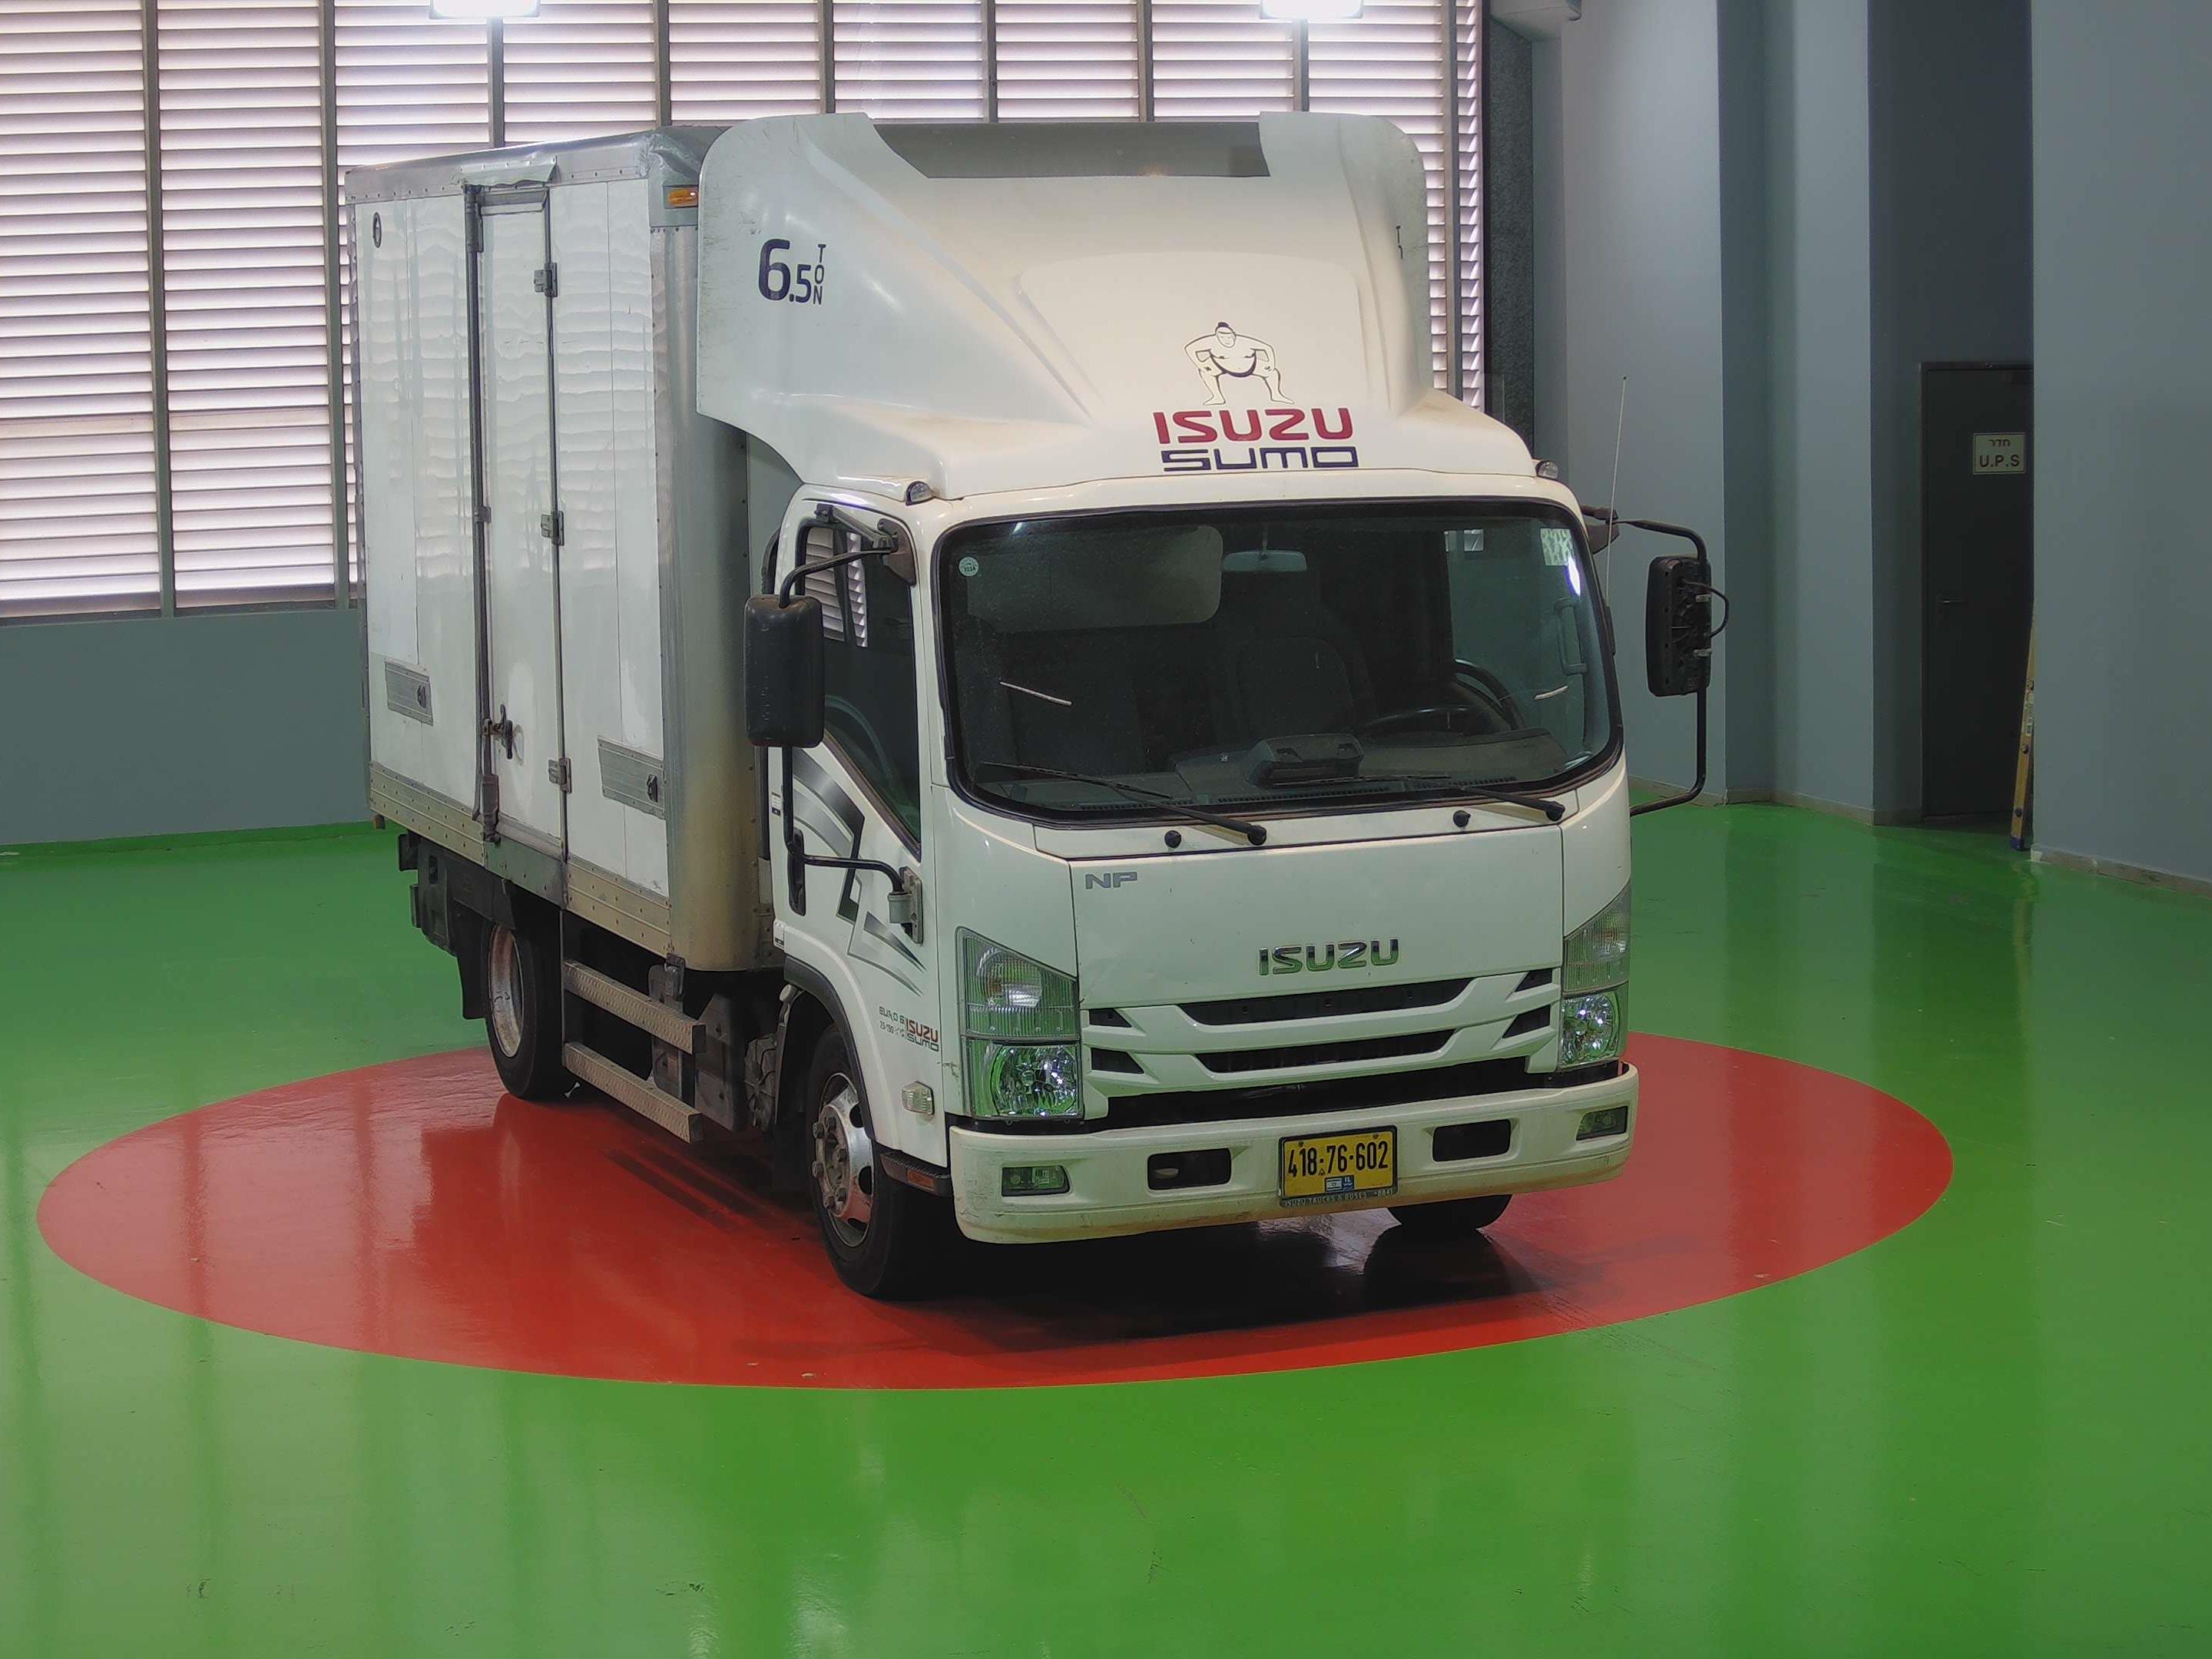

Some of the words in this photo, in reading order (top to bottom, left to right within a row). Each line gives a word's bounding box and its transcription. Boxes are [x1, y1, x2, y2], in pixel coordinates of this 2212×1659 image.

[758, 238, 811, 303] 6.5
[813, 243, 826, 305] TON
[1153, 408, 1353, 444] ISUZU
[1988, 439, 2011, 447] חדר
[1979, 454, 2020, 467] U.P.S
[1084, 871, 1137, 889] NP
[1258, 938, 1399, 975] ISUZU
[906, 1018, 939, 1043] ISUZU
